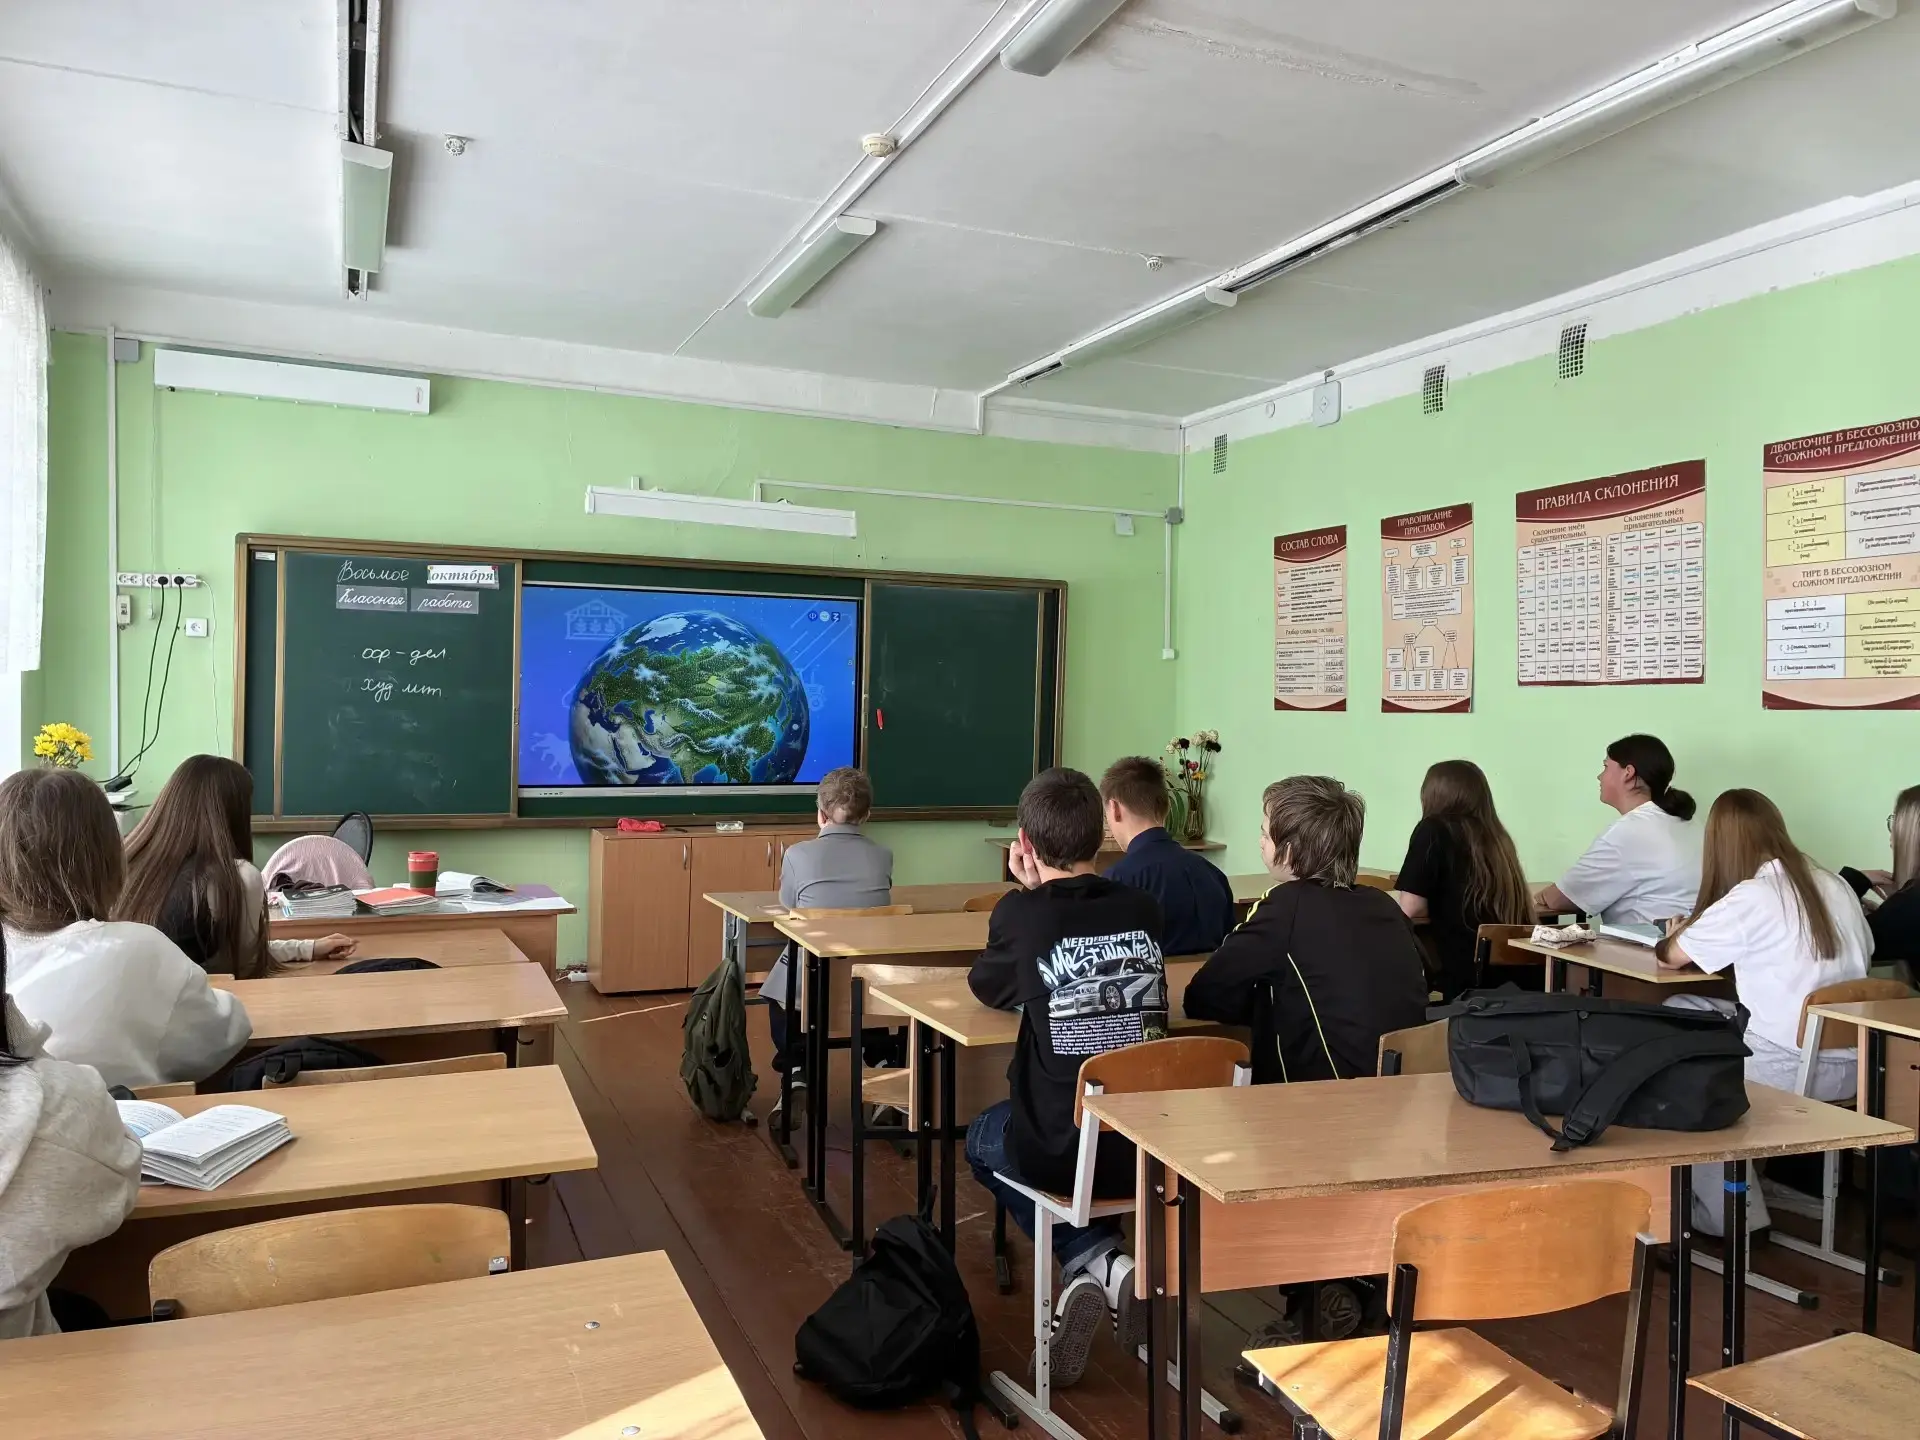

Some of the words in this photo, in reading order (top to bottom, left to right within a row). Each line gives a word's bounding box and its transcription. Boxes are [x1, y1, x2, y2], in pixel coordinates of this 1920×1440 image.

[1770, 434, 1833, 455] ДВОЕТОЧИЕ
[1836, 432, 1843, 442] В
[1846, 419, 1920, 441] БЕССОЮЗНО
[1775, 446, 1831, 465] СЛОЖНОМ
[1834, 431, 1920, 454] ПРЕДЛОЖЕНИИ
[1536, 490, 1591, 511] ПРАВИЛА
[1594, 474, 1679, 500] СКЛОНЕНИЯ
[1397, 509, 1453, 527] ПРАВОПИСАНИЕ
[1623, 510, 1663, 523] Склонение
[1664, 507, 1685, 517] имён
[1623, 515, 1684, 530] прилагательных
[1404, 521, 1446, 536] ПРИСТАВОК
[1530, 530, 1587, 544] существительных
[1532, 525, 1567, 537] Склонение
[1567, 523, 1586, 532] имён
[1280, 538, 1309, 552] СОСТАВ
[1311, 533, 1339, 546] СЛОВА
[337, 560, 410, 583] Восьмое
[431, 569, 495, 584] октября
[1802, 569, 1822, 578] ТИРЕ
[1823, 568, 1830, 576] В
[1831, 562, 1892, 575] БЕССОЮЗНОМ
[1792, 578, 1835, 588] СЛОЖНОМ
[1836, 571, 1902, 585] ПРЕДЛОЖЕНИИ
[338, 587, 406, 606] Классная
[417, 592, 473, 610] работа
[1061, 936, 1094, 949] NEED
[1093, 935, 1109, 943] FOR
[1109, 930, 1145, 943] SPEED
